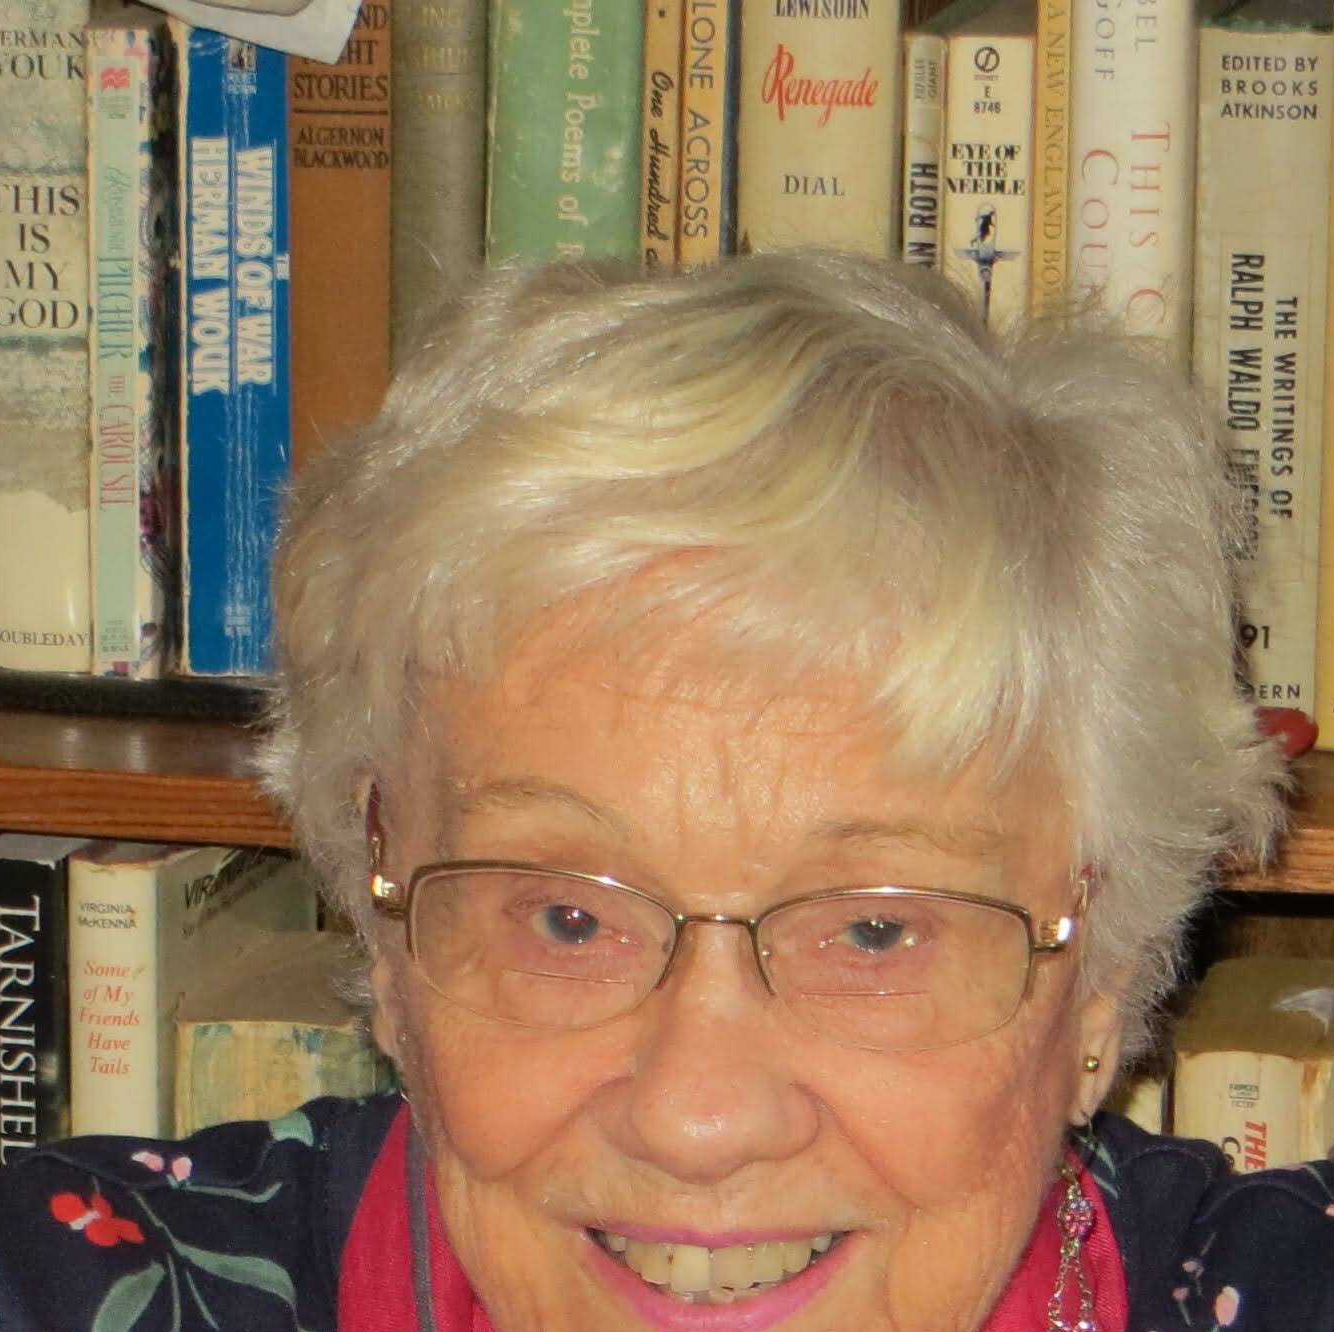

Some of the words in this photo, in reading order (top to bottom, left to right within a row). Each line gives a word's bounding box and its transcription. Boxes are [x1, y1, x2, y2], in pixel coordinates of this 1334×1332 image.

[1046, 32, 1065, 97] NEW
[1222, 55, 1287, 73] EDITED
[1294, 56, 1319, 74] BY
[294, 76, 388, 100] STORIES
[650, 71, 675, 119] One
[762, 43, 878, 128] Renegade
[984, 86, 991, 99] E
[1221, 79, 1319, 96] BROOKS
[1220, 103, 1318, 120] ATKINSON
[298, 128, 384, 146] ALGERNON
[561, 93, 603, 183] Poems
[951, 144, 990, 161] EYE
[994, 144, 1021, 161] OF
[296, 151, 389, 170] BLACKWOOD
[684, 109, 711, 239] ACROSS
[963, 161, 1007, 178] THE
[1043, 105, 1063, 241] ENGLAND
[646, 128, 671, 241] Hundred
[783, 175, 845, 197] DIAL
[909, 163, 939, 228] ROTH
[946, 178, 1025, 196] NEEDLE
[1130, 122, 1171, 250] THIS
[191, 137, 228, 280] HERMAN
[236, 147, 272, 257] WINDS
[557, 195, 588, 227] of
[19, 223, 50, 252] IS
[5, 260, 57, 290] MY
[237, 262, 272, 309] OF
[1230, 253, 1264, 331] RALPH
[97, 256, 134, 361] PILCHER
[1274, 297, 1297, 339] THE
[192, 289, 229, 395] WOUK
[237, 314, 272, 385] WAR
[1227, 348, 1263, 431] WALDO
[1271, 353, 1296, 477] WRITINGS
[99, 404, 133, 511] CAROUSEL
[1270, 490, 1293, 519] OF
[77, 916, 137, 928] McKENNA
[78, 902, 134, 915] VIRGINIA
[84, 960, 130, 977] Some
[84, 984, 102, 1001] of
[78, 1007, 140, 1027] Friends
[87, 1034, 130, 1050] Have
[90, 1056, 129, 1074] Tails
[1244, 1121, 1266, 1171] THE
